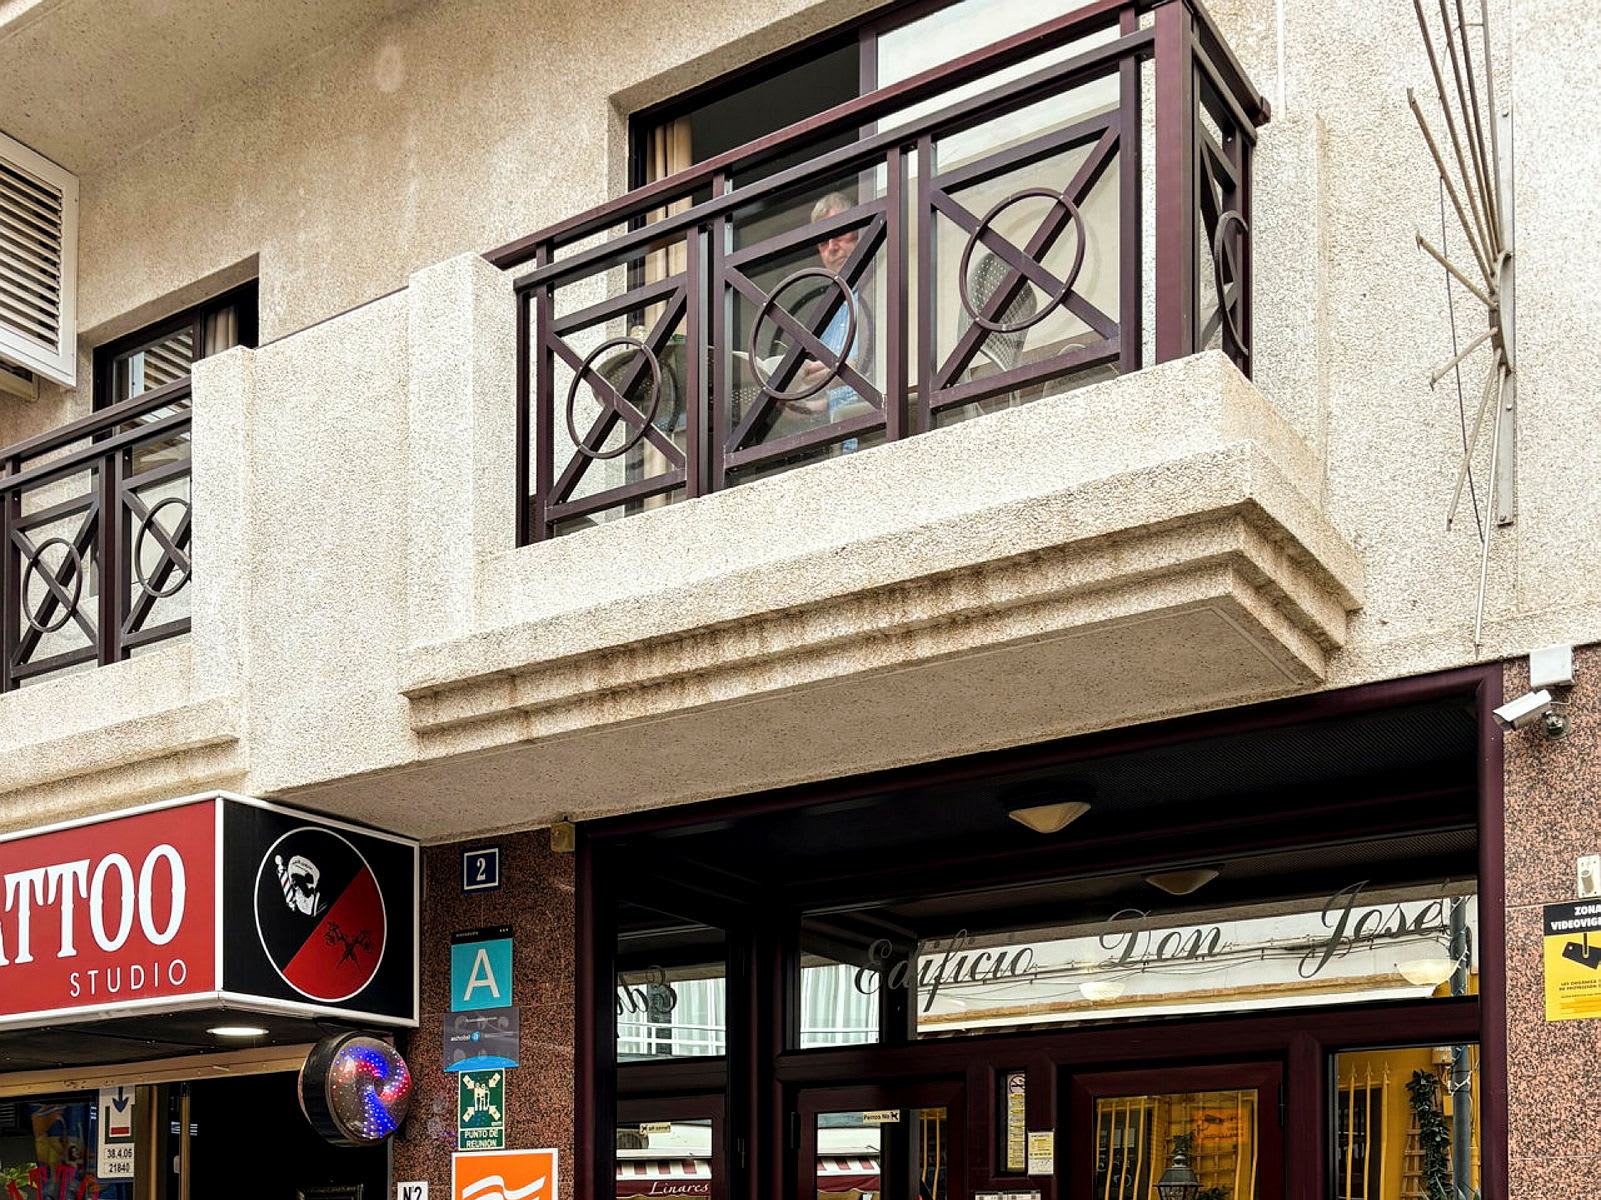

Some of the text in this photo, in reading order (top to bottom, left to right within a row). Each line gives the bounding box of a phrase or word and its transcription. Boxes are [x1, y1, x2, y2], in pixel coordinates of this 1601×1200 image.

[476, 857, 486, 881] 2
[1574, 904, 1601, 916] ZONA
[854, 928, 1036, 1012] Edificio
[1099, 908, 1230, 966] Don
[69, 958, 187, 998] STUDIO
[463, 948, 500, 1001] A
[465, 1128, 499, 1138] PUNTO DE
[649, 1181, 709, 1195] Linares
